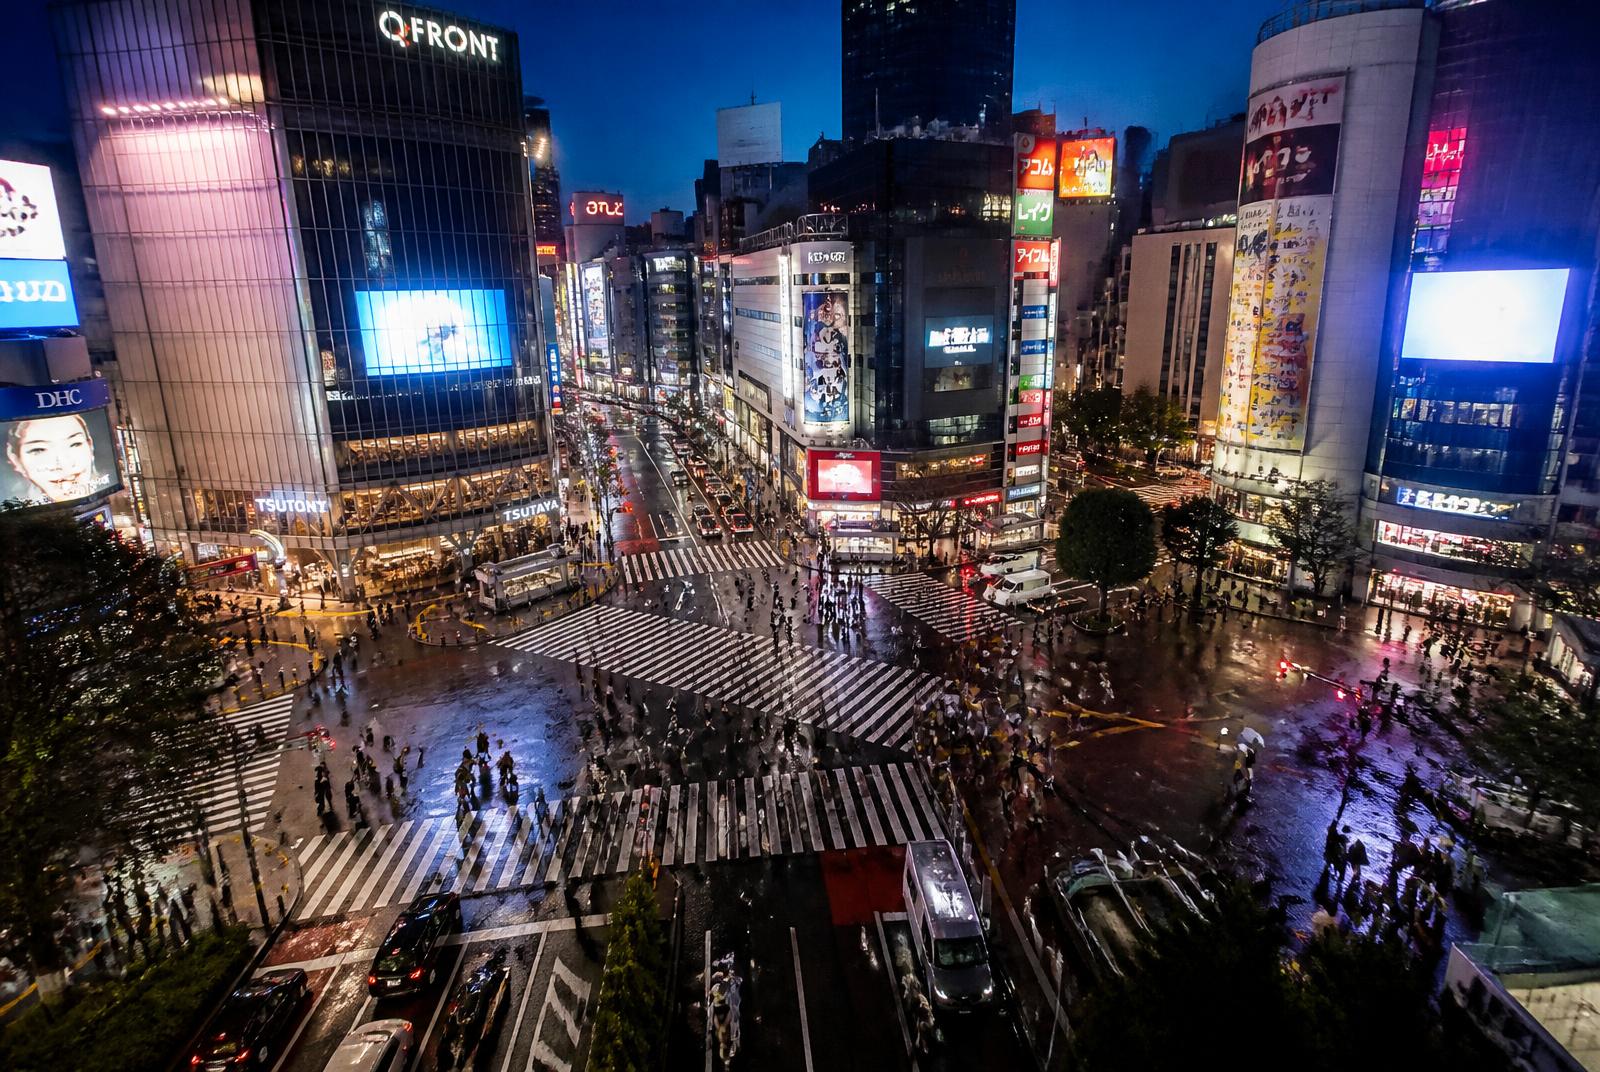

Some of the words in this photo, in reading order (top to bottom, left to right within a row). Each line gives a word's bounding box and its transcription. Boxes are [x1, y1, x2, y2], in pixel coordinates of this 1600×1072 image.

[1019, 157, 1054, 176] アコム
[1017, 202, 1051, 222] レイク
[35, 389, 82, 409] DHC
[503, 500, 559, 521] TSUTAYA
